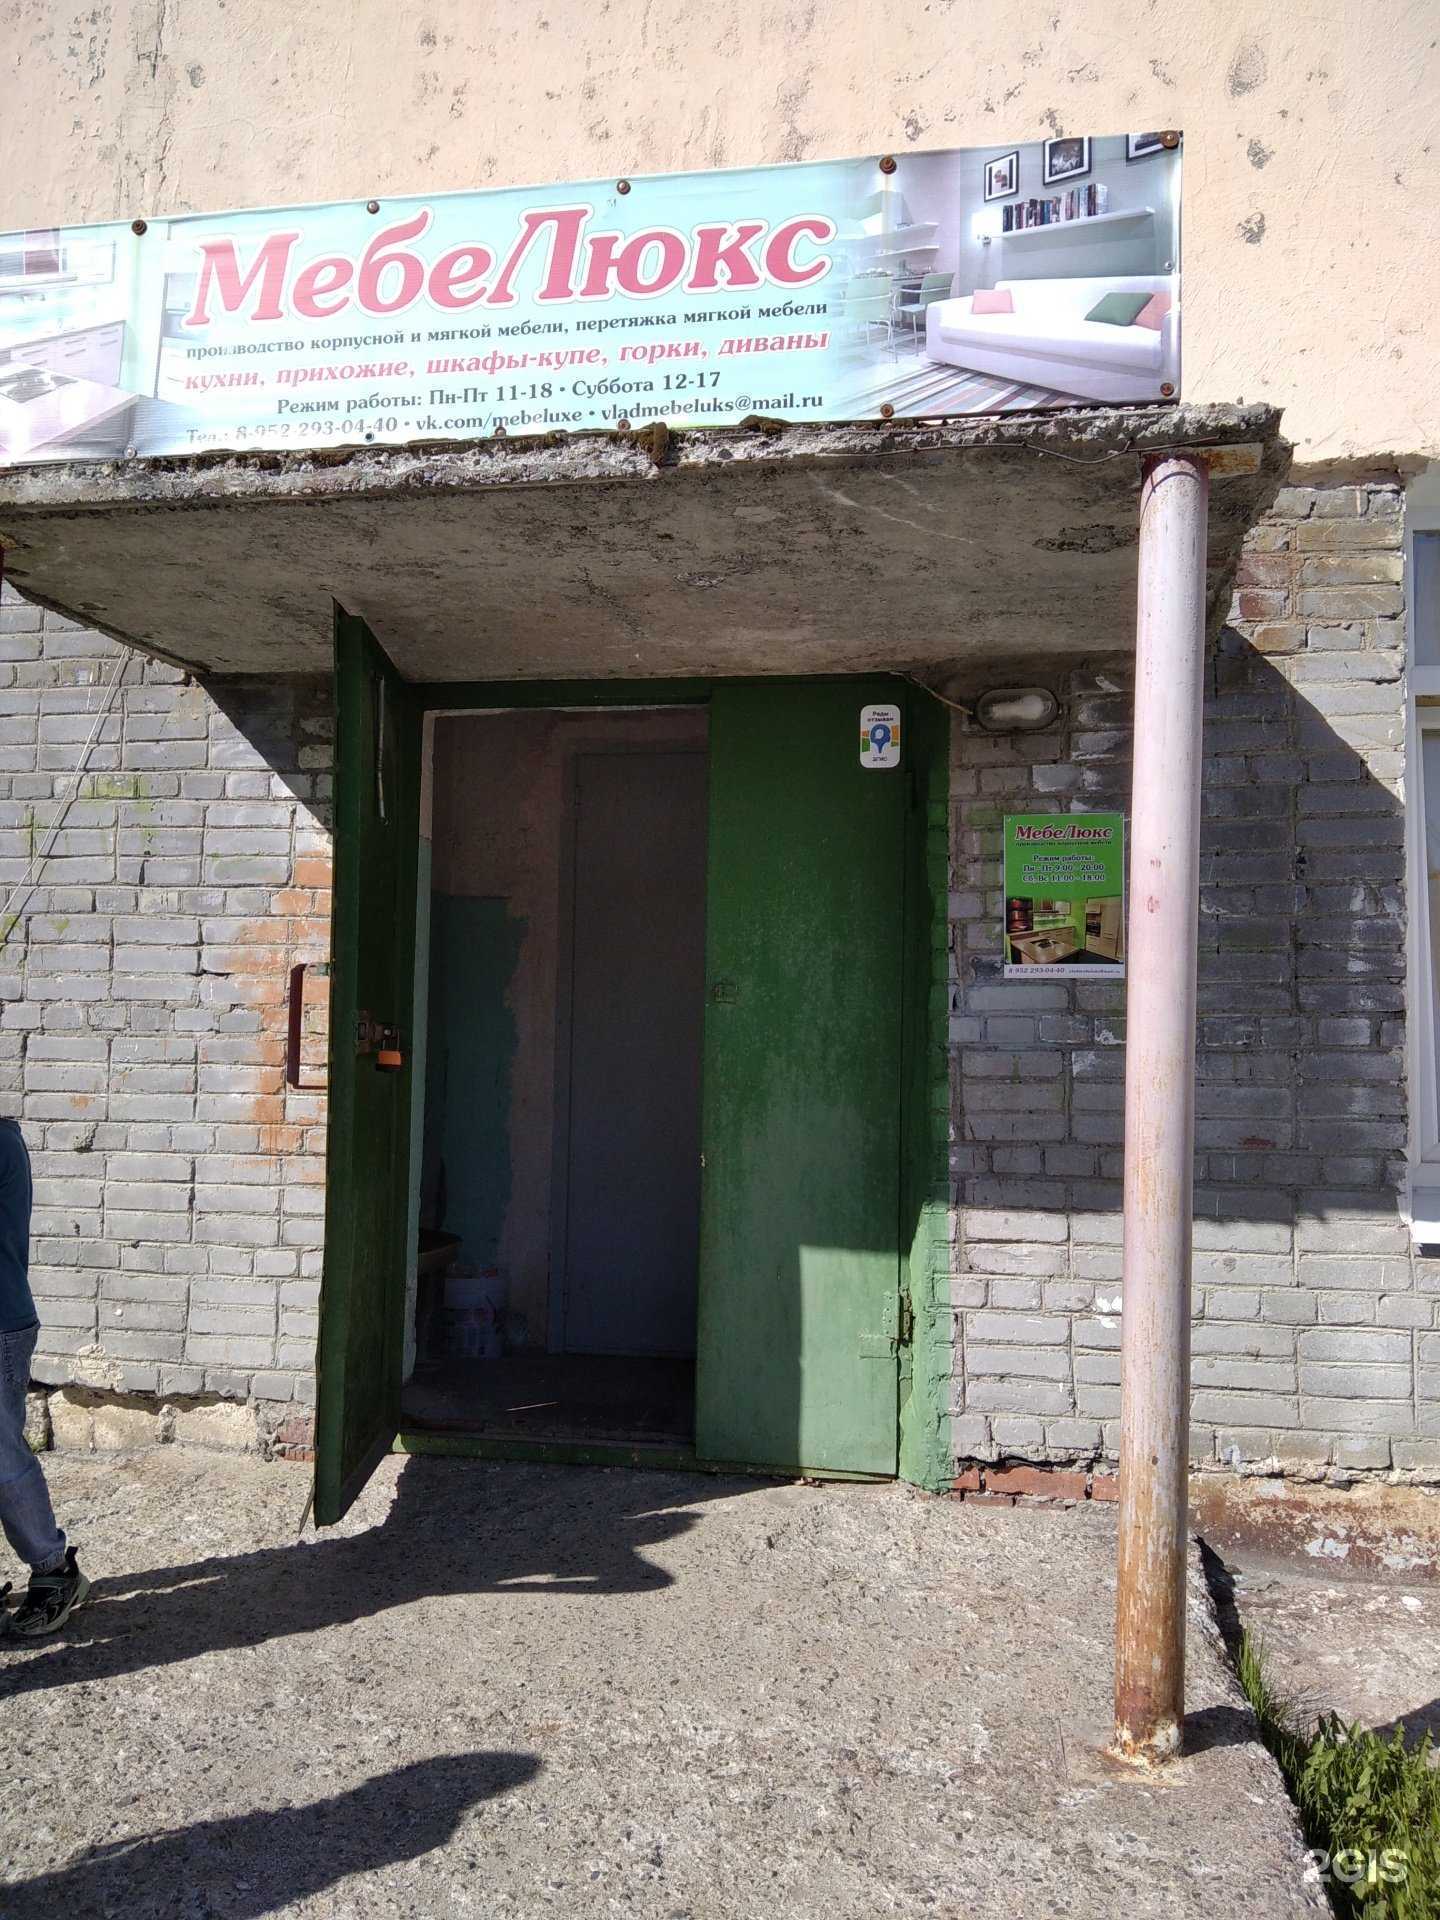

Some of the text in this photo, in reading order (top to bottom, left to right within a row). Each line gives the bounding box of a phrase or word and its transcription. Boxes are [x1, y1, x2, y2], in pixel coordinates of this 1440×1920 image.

[186, 209, 832, 326] МебеЛюкс
[311, 331, 404, 353] корпусной
[411, 333, 421, 343] и
[428, 324, 491, 342] мягкой
[498, 319, 569, 337] мебели,
[576, 315, 677, 333] перетяжка
[684, 306, 751, 324] мягкой
[758, 300, 828, 318] мебели
[185, 332, 829, 393] кухни, прихожие, шкафы-купе, горки, диваны
[277, 371, 721, 415] Режим работы: Пн-Пт 11-18 Суббота 12-17
[416, 408, 583, 432] vk.com/mebeluxe
[602, 393, 824, 421] vladmebeluks@mail.ru
[1016, 824, 1113, 841] МебеЛюкс
